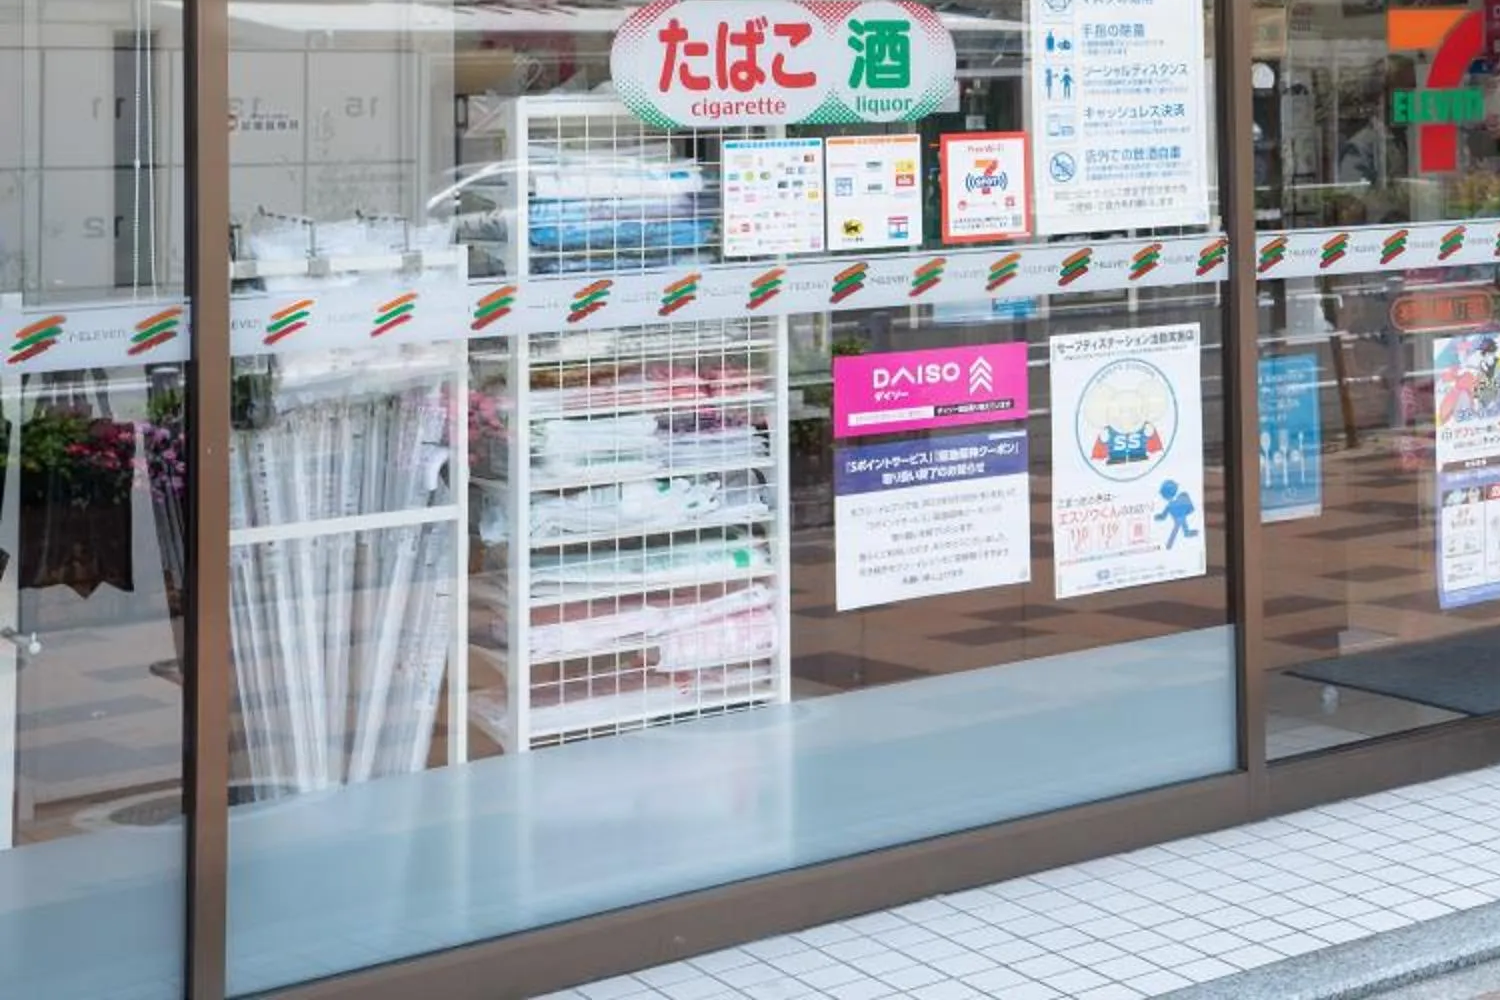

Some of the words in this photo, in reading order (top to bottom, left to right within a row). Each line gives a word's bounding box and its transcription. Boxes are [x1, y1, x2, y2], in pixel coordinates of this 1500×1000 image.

[658, 16, 817, 92] たばこ
[847, 18, 911, 89] 酒
[691, 96, 786, 119] cigarette
[856, 95, 913, 115] liquor
[873, 362, 961, 389] DAISO
[1114, 434, 1141, 451] SS
